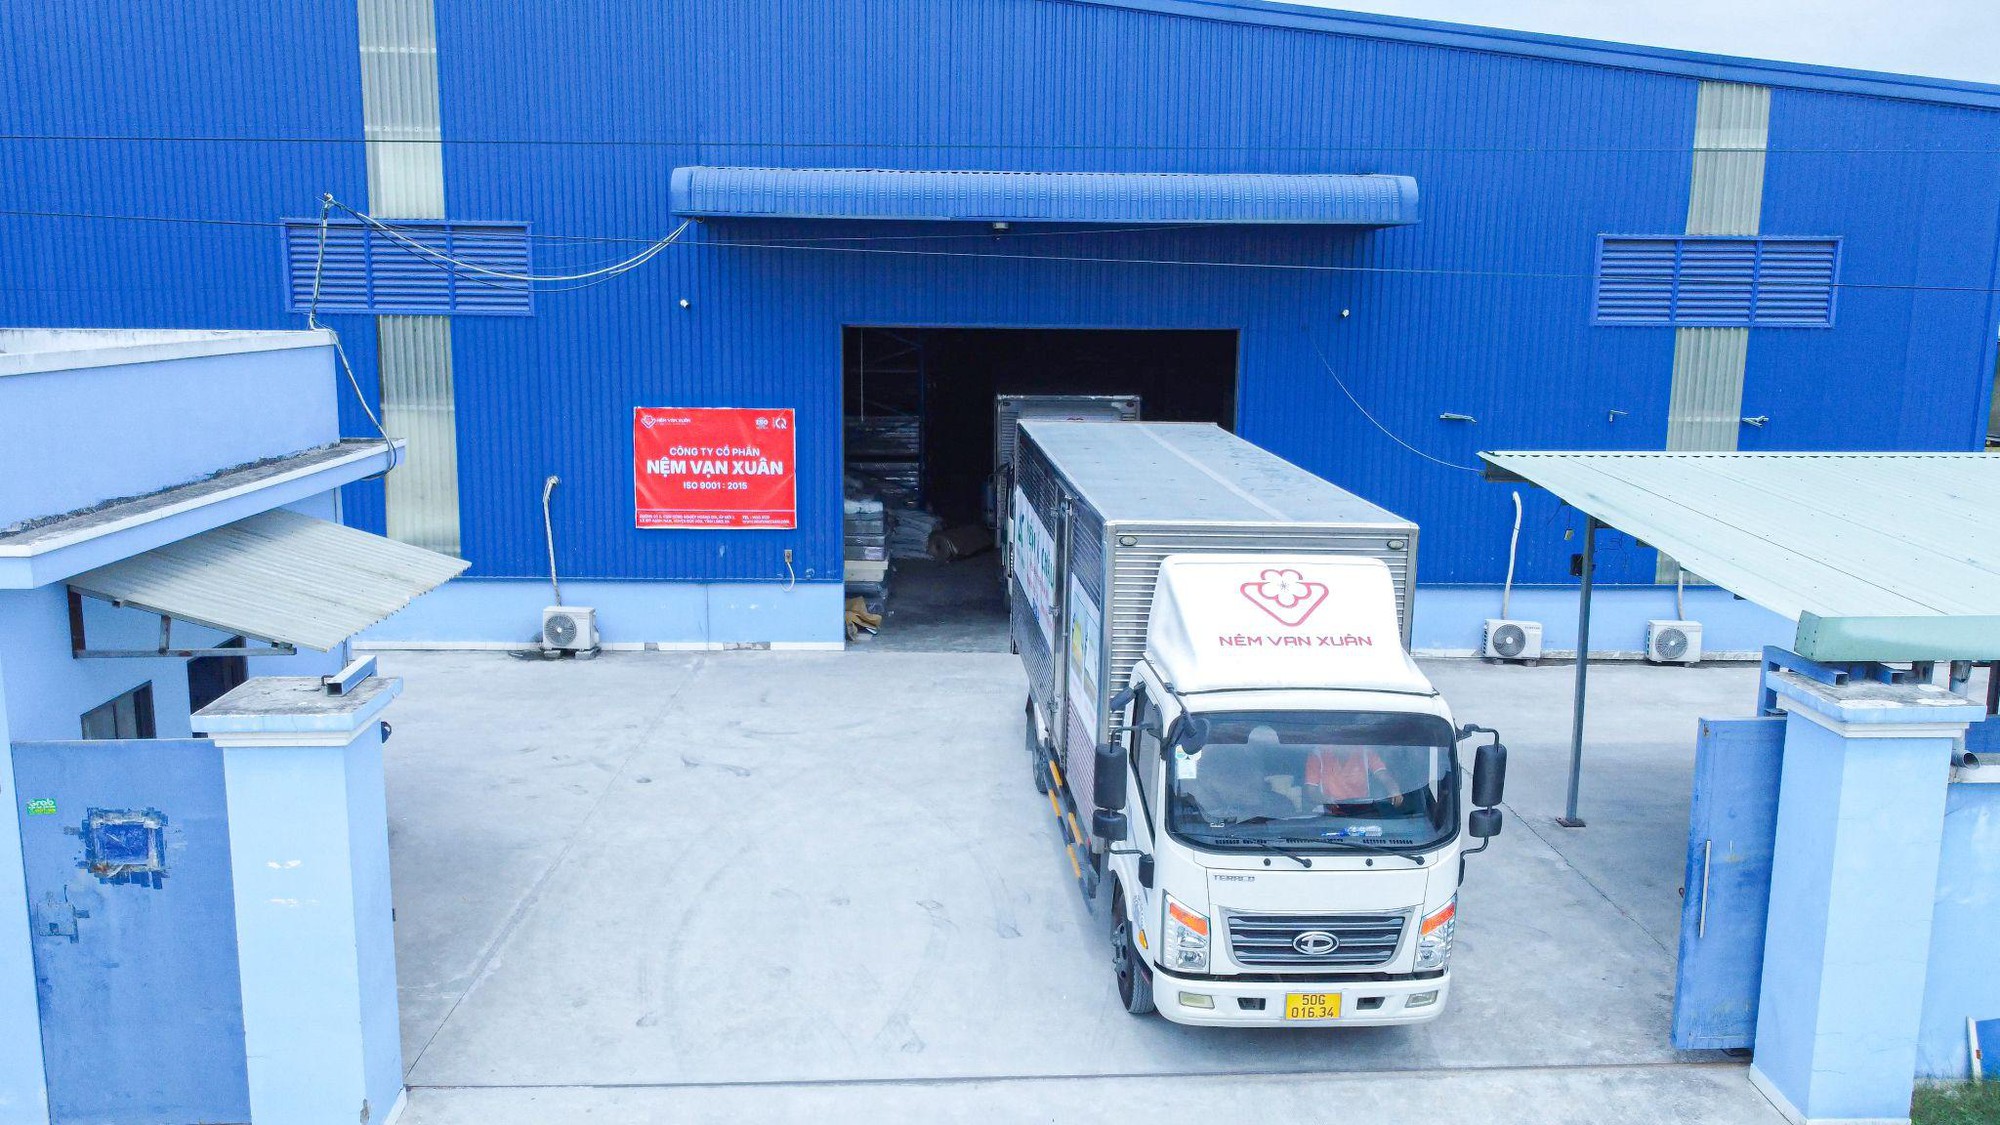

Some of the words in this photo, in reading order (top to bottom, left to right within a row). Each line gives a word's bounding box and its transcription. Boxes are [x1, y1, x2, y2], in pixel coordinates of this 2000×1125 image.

[669, 445, 698, 456] CÔNG
[700, 447, 713, 456] TY
[646, 456, 687, 477] NỆM
[689, 460, 728, 478] VẠN
[732, 457, 783, 475] XUÂN
[683, 481, 698, 489] ISO
[700, 481, 721, 489] 9001
[728, 481, 748, 489] 2015
[1316, 634, 1373, 647] XUÂN
[1302, 994, 1326, 1006] 50G
[1291, 1006, 1334, 1018] 016.34
